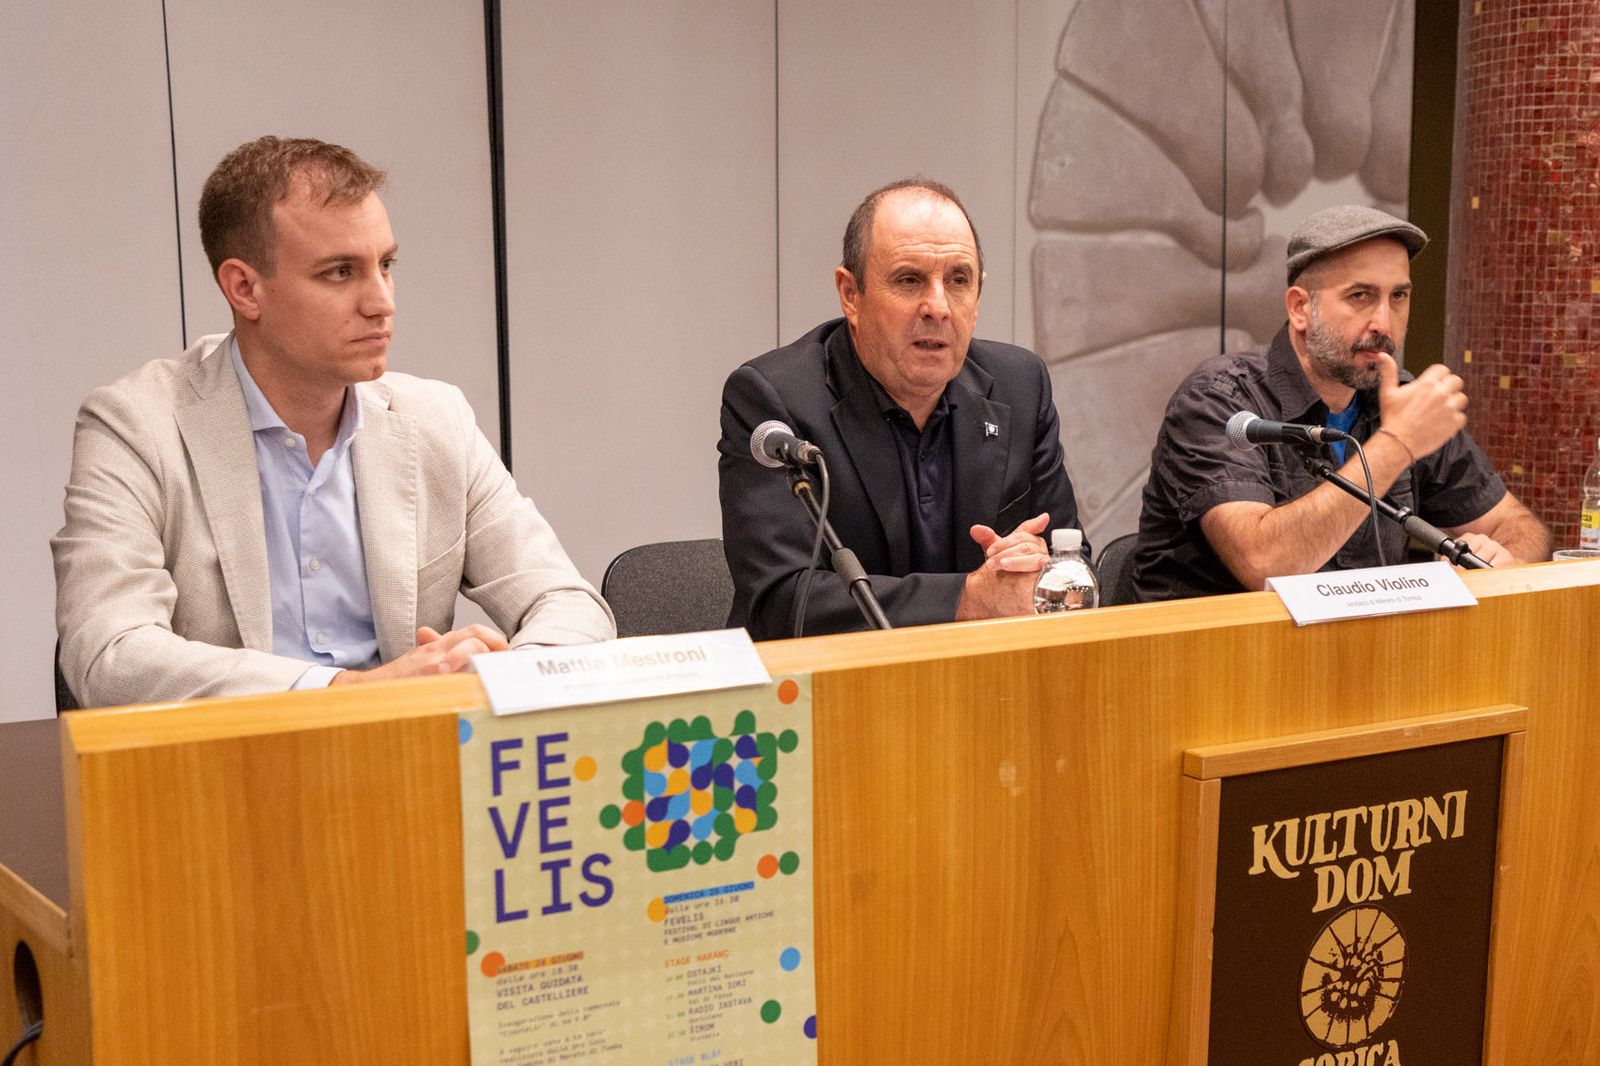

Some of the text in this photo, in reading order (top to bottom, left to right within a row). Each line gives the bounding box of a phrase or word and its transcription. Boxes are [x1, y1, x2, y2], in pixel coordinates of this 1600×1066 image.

[1316, 577, 1430, 597] Claudio Violino
[536, 645, 707, 676] Mattia Mestroni
[490, 732, 571, 797] FE
[487, 796, 572, 860] VE
[1248, 790, 1468, 879] KULTURNI
[494, 853, 614, 924] LIS
[1311, 850, 1415, 913] DOM
[664, 911, 704, 926] FEVELIS
[496, 974, 583, 998] VISITA GUIDATA
[496, 986, 588, 1011] DEL CASTELLIERE
[718, 996, 752, 1009] ZASTAVA
[1299, 1040, 1402, 1066] ICA
